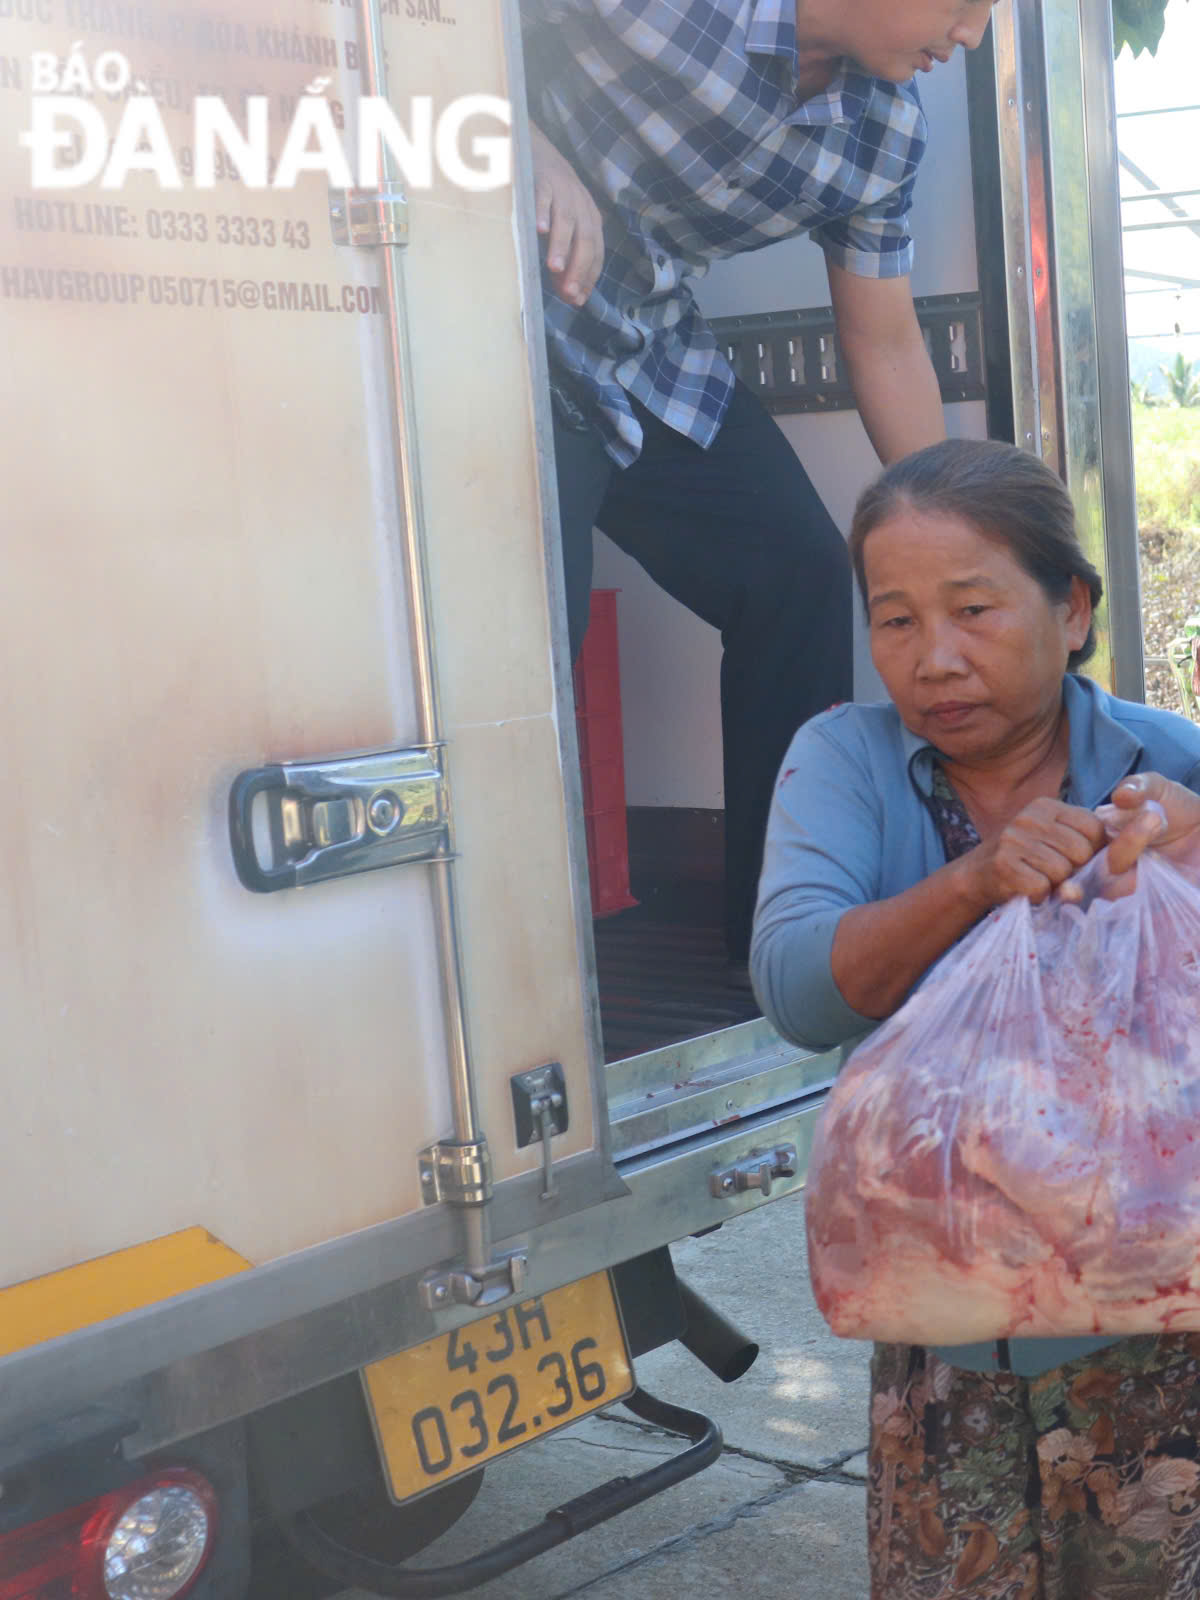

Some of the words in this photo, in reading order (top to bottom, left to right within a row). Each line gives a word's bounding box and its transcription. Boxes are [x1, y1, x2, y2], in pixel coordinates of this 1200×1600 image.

[14, 197, 138, 240] HOTLINE:
[146, 208, 210, 243] 0333
[217, 214, 278, 249] 3333
[282, 219, 311, 250] 43
[446, 1295, 552, 1374] 43H
[411, 1336, 607, 1476] 032.36
